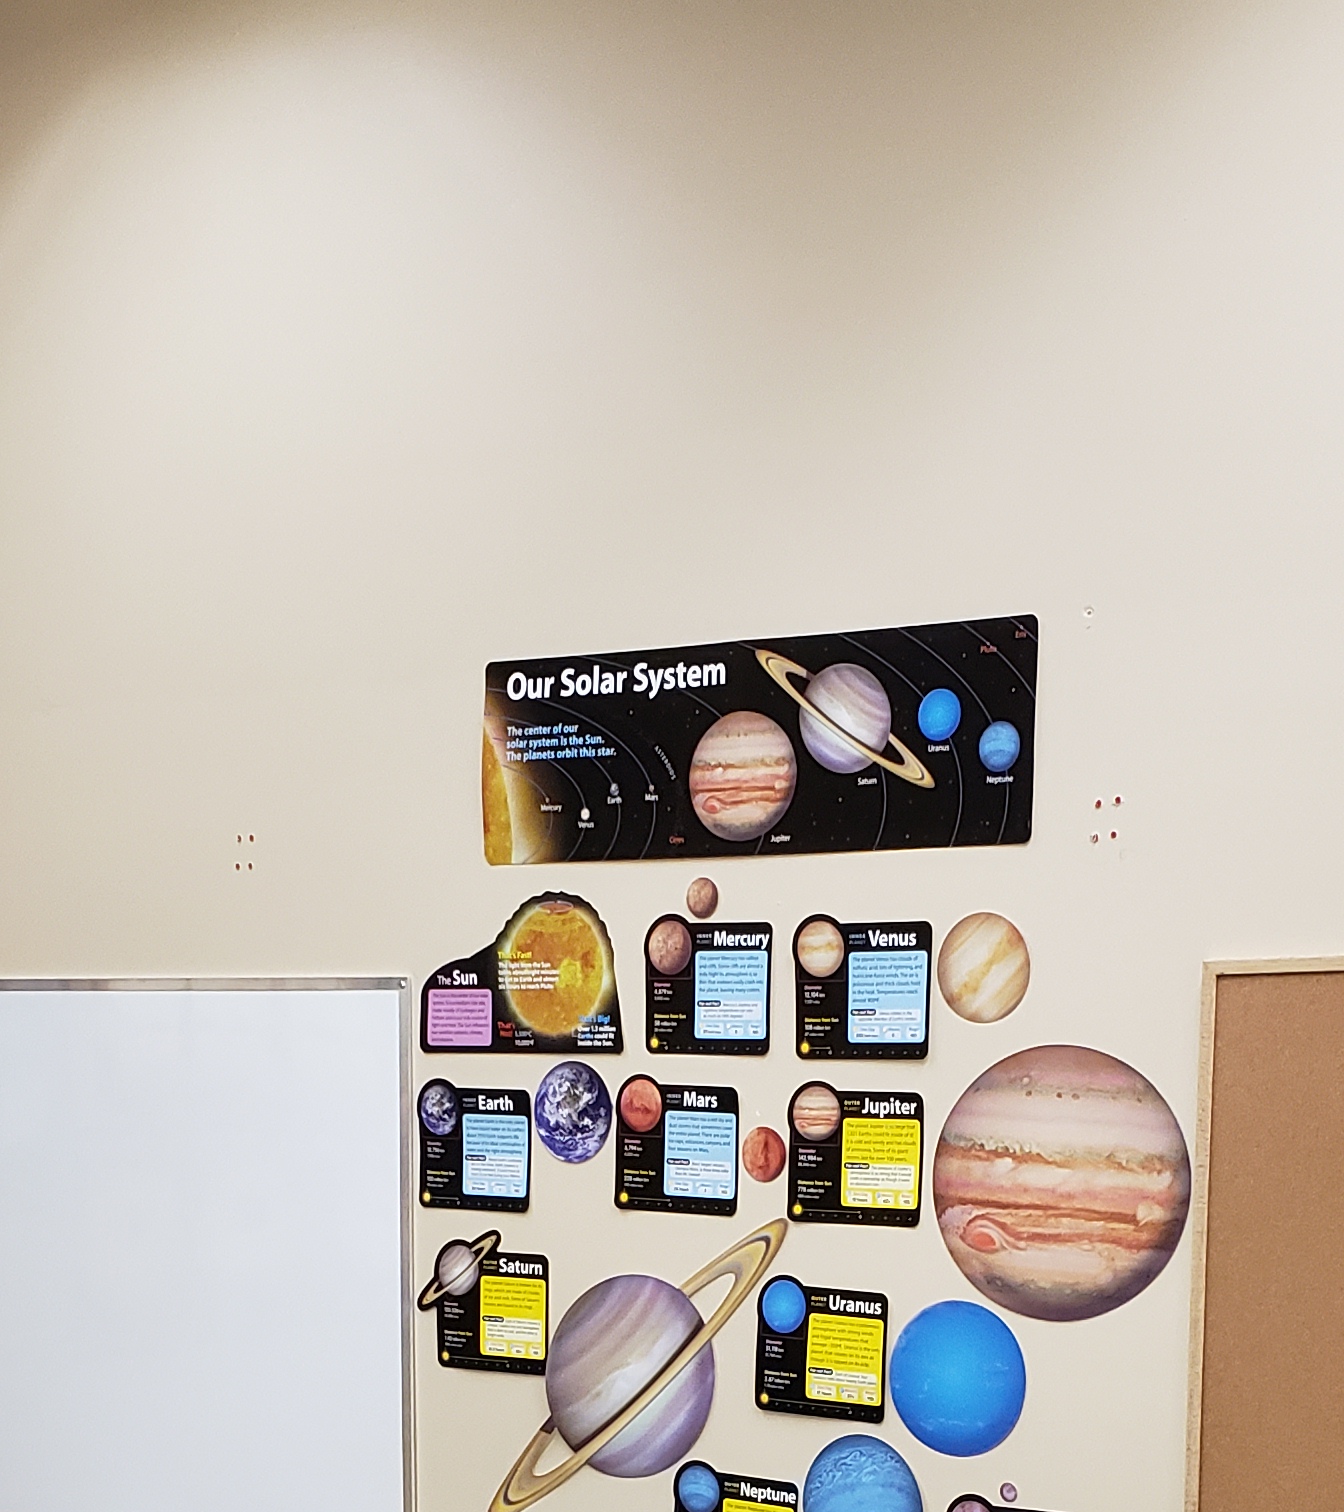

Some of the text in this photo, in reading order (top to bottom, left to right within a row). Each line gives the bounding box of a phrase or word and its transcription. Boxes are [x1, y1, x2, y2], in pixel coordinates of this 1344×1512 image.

[506, 662, 726, 700] Our Solar System
[506, 723, 579, 737] The center of our
[506, 734, 605, 750] solar system is the Sun.
[506, 746, 617, 763] The planets orbit this star.
[713, 930, 770, 950] Mercury
[868, 929, 918, 947] Venus
[437, 970, 478, 986] The Sun
[478, 1094, 514, 1111] Earth
[683, 1091, 718, 1108] Mars
[862, 1097, 917, 1118] Jupiter
[499, 1258, 543, 1275] Saturn
[829, 1294, 882, 1315] Uranus
[739, 1481, 796, 1504] Neptune
